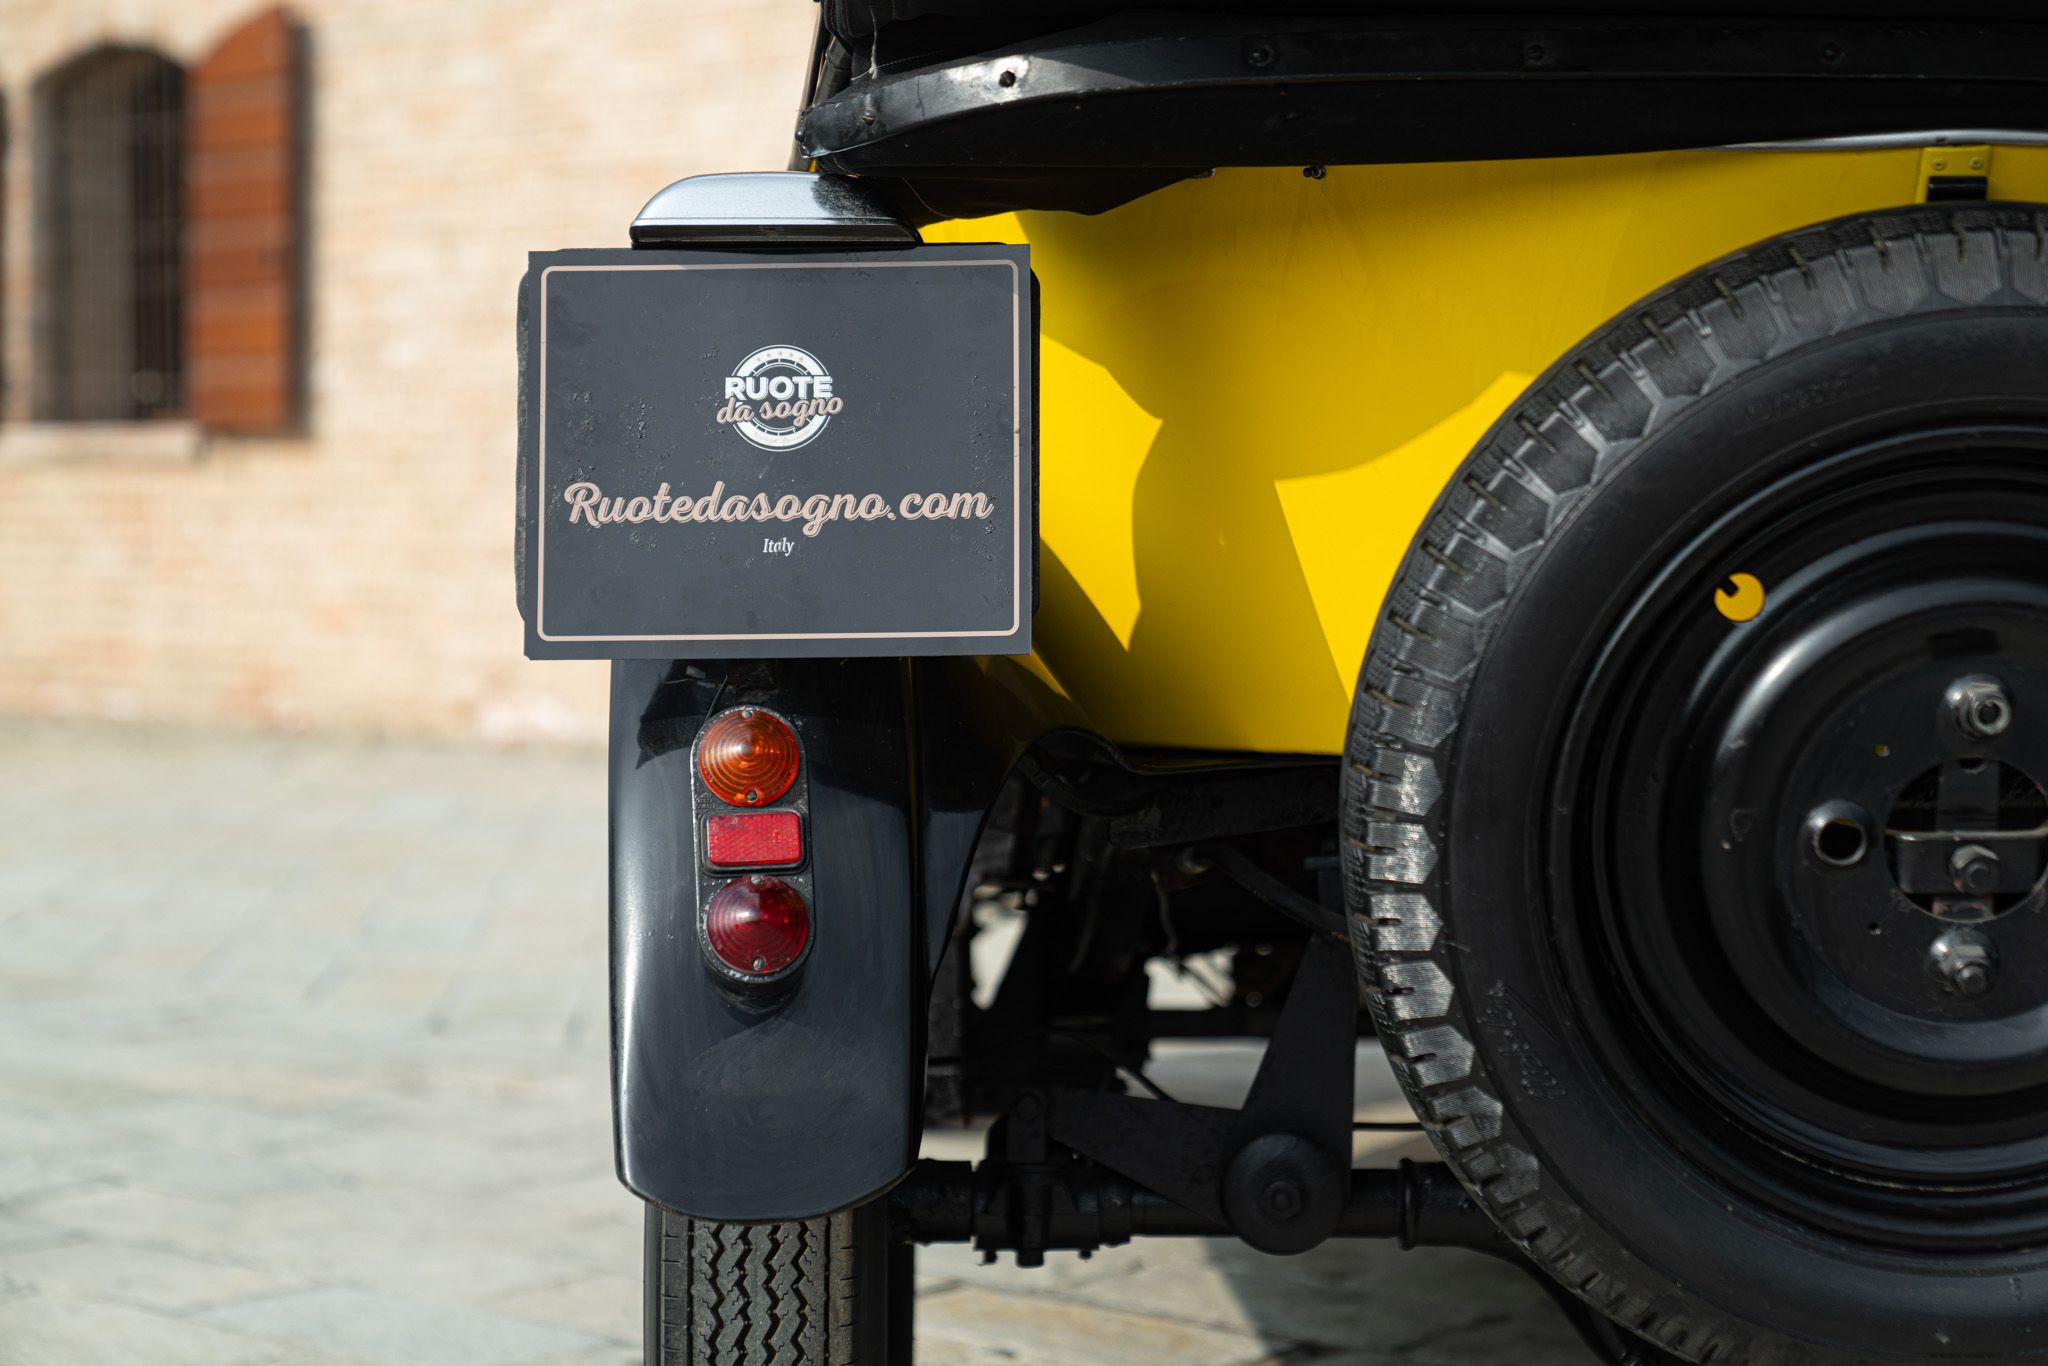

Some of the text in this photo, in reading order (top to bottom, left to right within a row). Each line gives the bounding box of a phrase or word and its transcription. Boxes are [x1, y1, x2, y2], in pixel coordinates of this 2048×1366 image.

[724, 375, 833, 401] RUOTE
[716, 396, 844, 427] da sogno
[563, 480, 995, 538] Ruotedasogno.com
[762, 537, 795, 557] Italy
